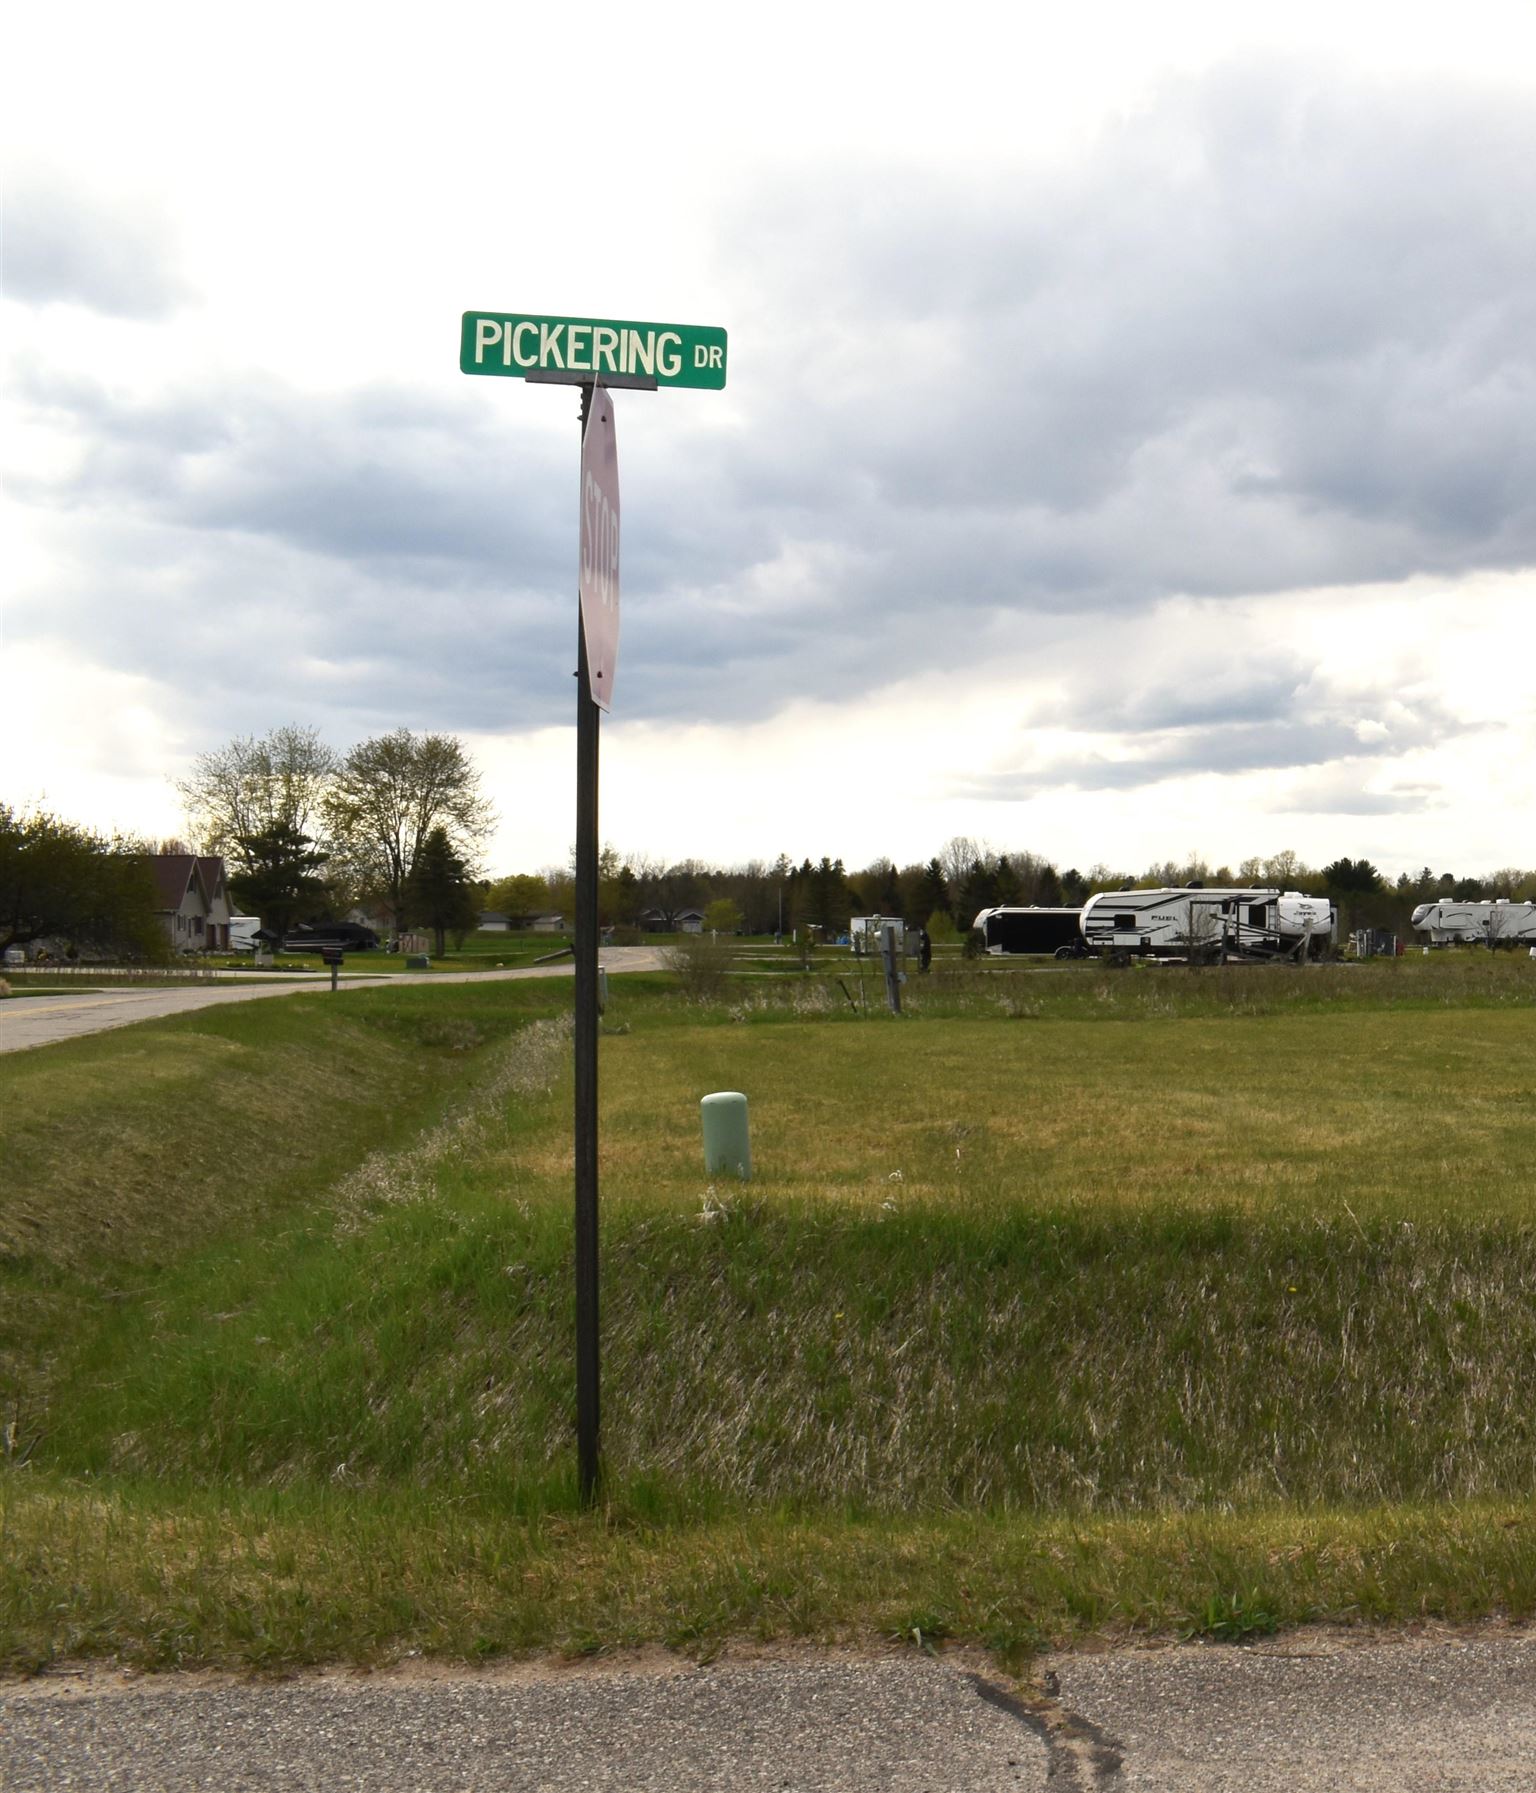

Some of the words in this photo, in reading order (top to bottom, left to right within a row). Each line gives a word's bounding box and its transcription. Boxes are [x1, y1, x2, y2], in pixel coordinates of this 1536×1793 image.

[475, 319, 682, 377] PICKERING
[694, 345, 723, 369] DR
[584, 470, 618, 613] STOP
